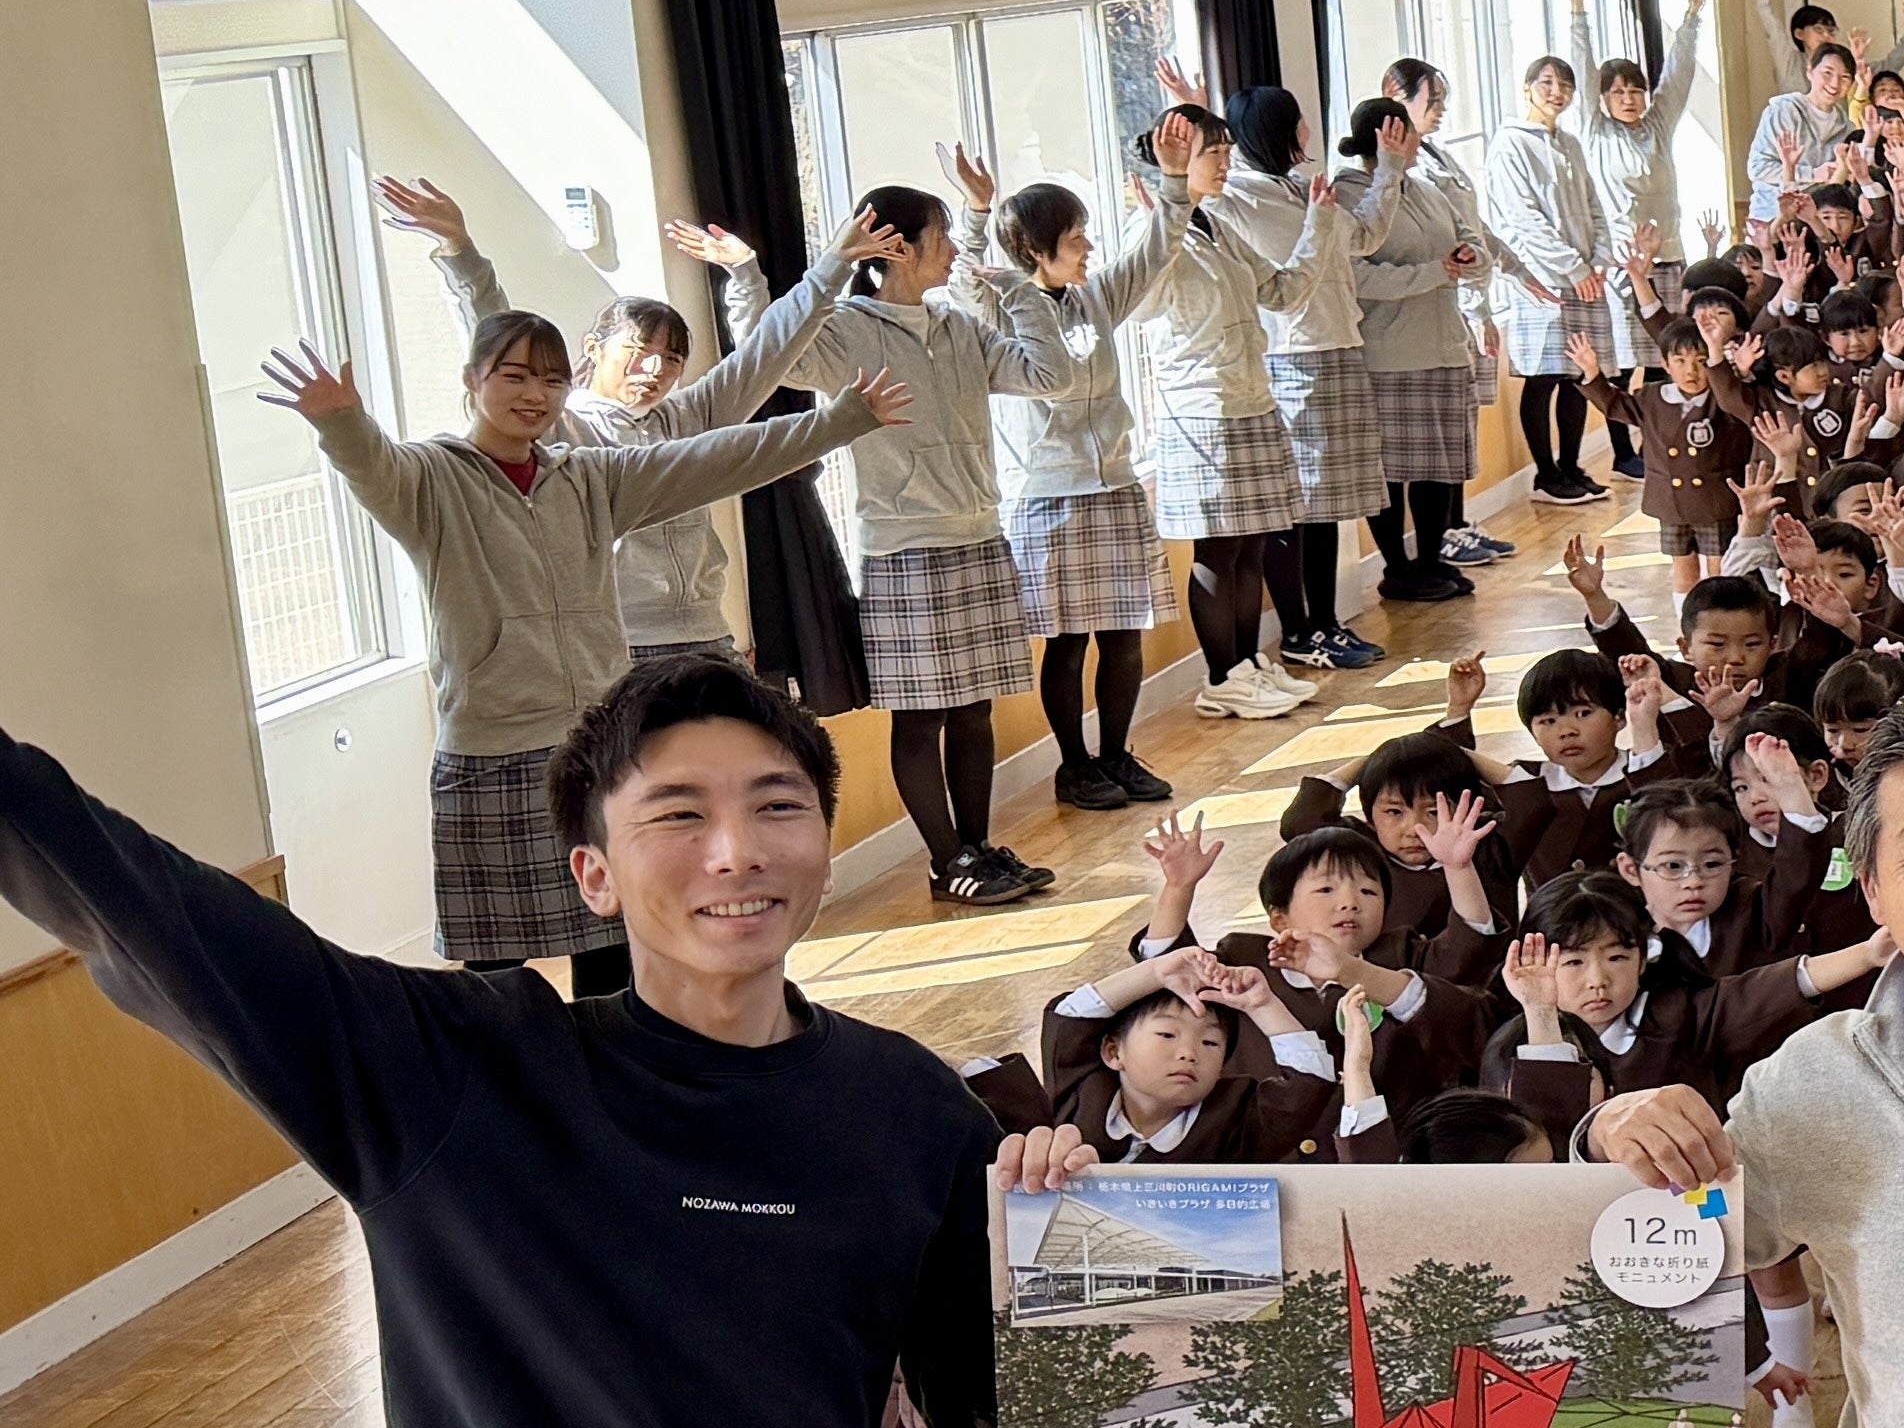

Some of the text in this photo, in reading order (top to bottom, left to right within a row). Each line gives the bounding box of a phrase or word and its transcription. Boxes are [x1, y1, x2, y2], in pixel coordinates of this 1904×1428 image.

[682, 1196, 796, 1215] NOZAWA MOKKOU
[1624, 1217, 1697, 1245] 12m
[1609, 1256, 1709, 1269] おおきな折り紙
[1617, 1272, 1702, 1284] モニュメント
